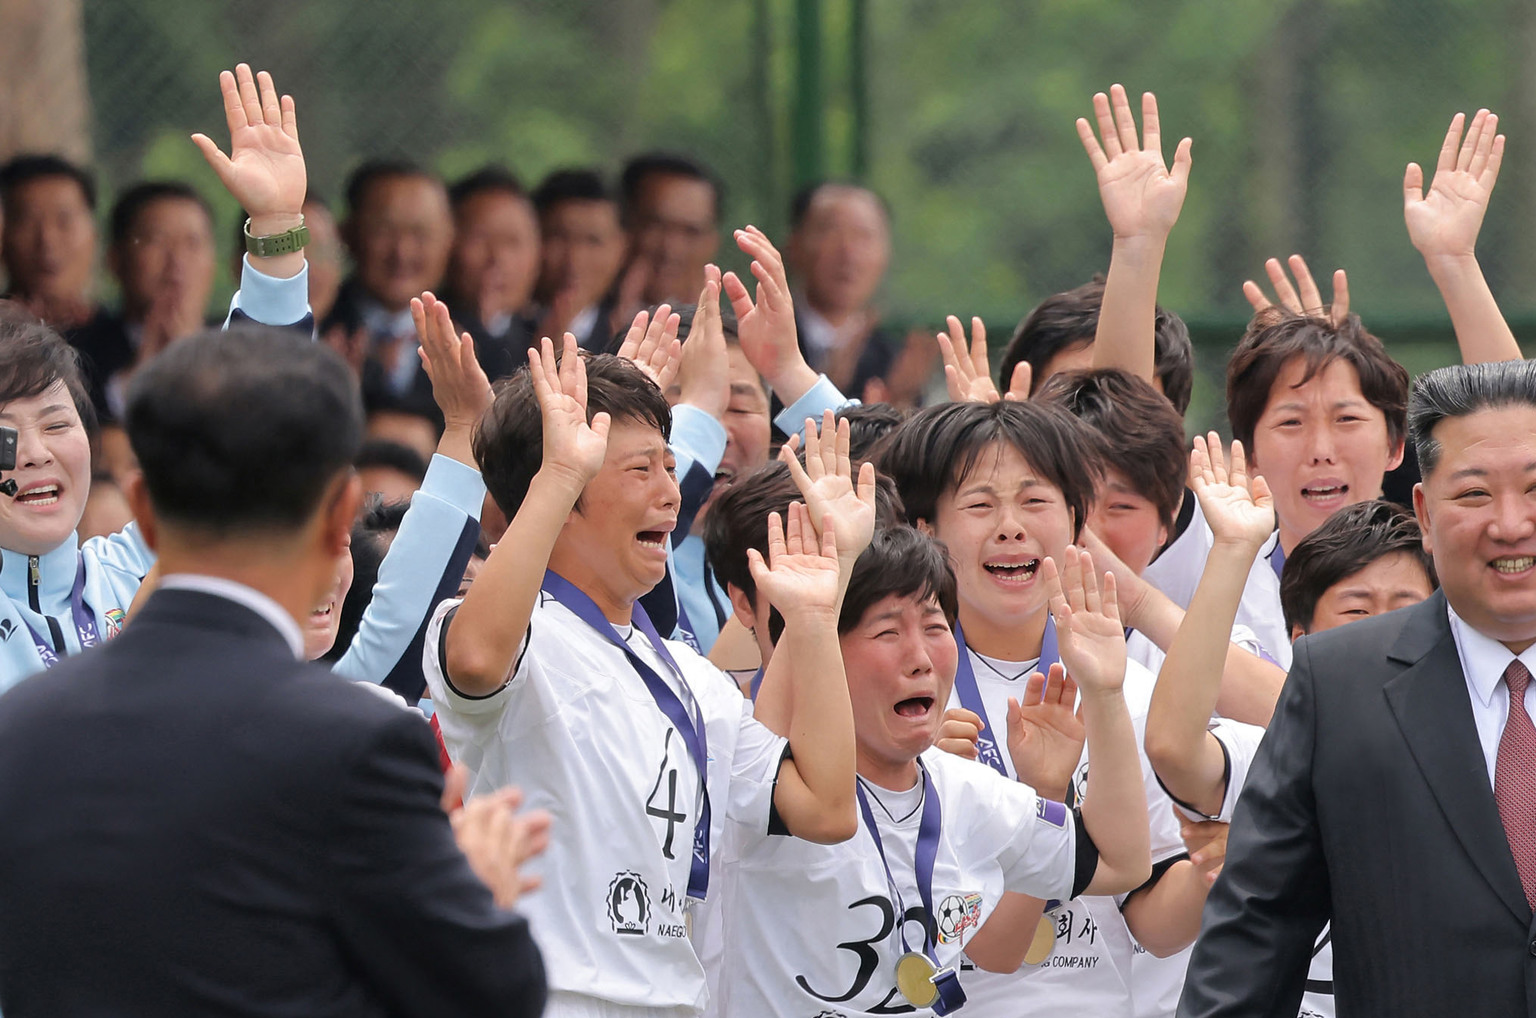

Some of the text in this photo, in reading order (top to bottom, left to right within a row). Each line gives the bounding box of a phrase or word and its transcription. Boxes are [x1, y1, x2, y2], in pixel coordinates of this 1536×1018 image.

[646, 727, 686, 860] 4
[657, 923, 687, 938] NAEGO
[795, 894, 938, 1015] 32
[1052, 955, 1100, 969] COMPANY
